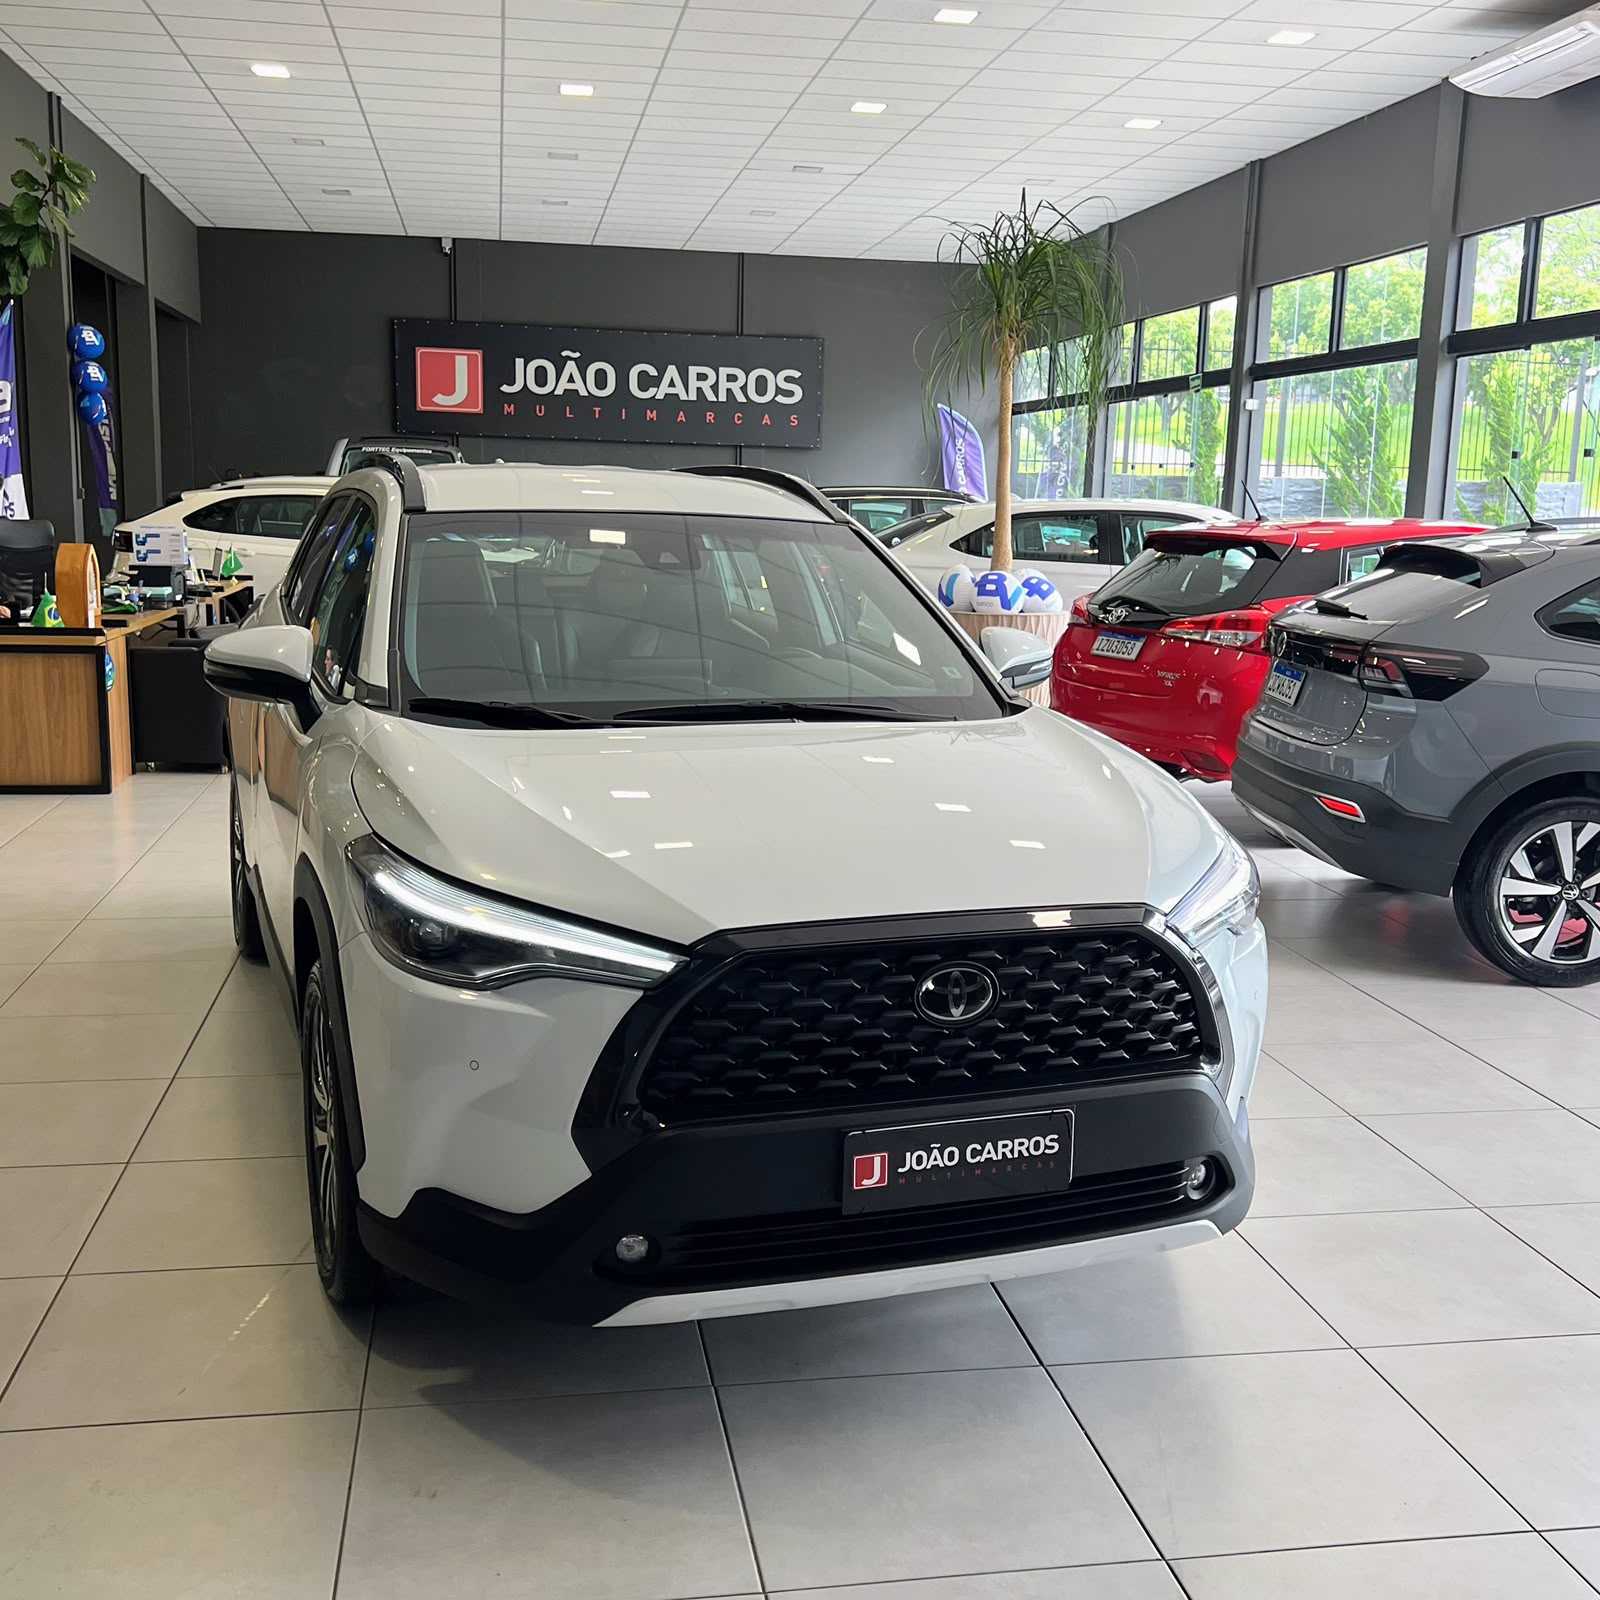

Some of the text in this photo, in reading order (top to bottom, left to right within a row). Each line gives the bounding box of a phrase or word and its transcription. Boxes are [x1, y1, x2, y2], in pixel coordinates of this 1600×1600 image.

[432, 354, 468, 406] J
[499, 350, 803, 405] JOÃO CARROS
[503, 403, 800, 427] MULTIMARCAS
[861, 1156, 881, 1186] J
[897, 1134, 1060, 1173] JOÃO CARROS
